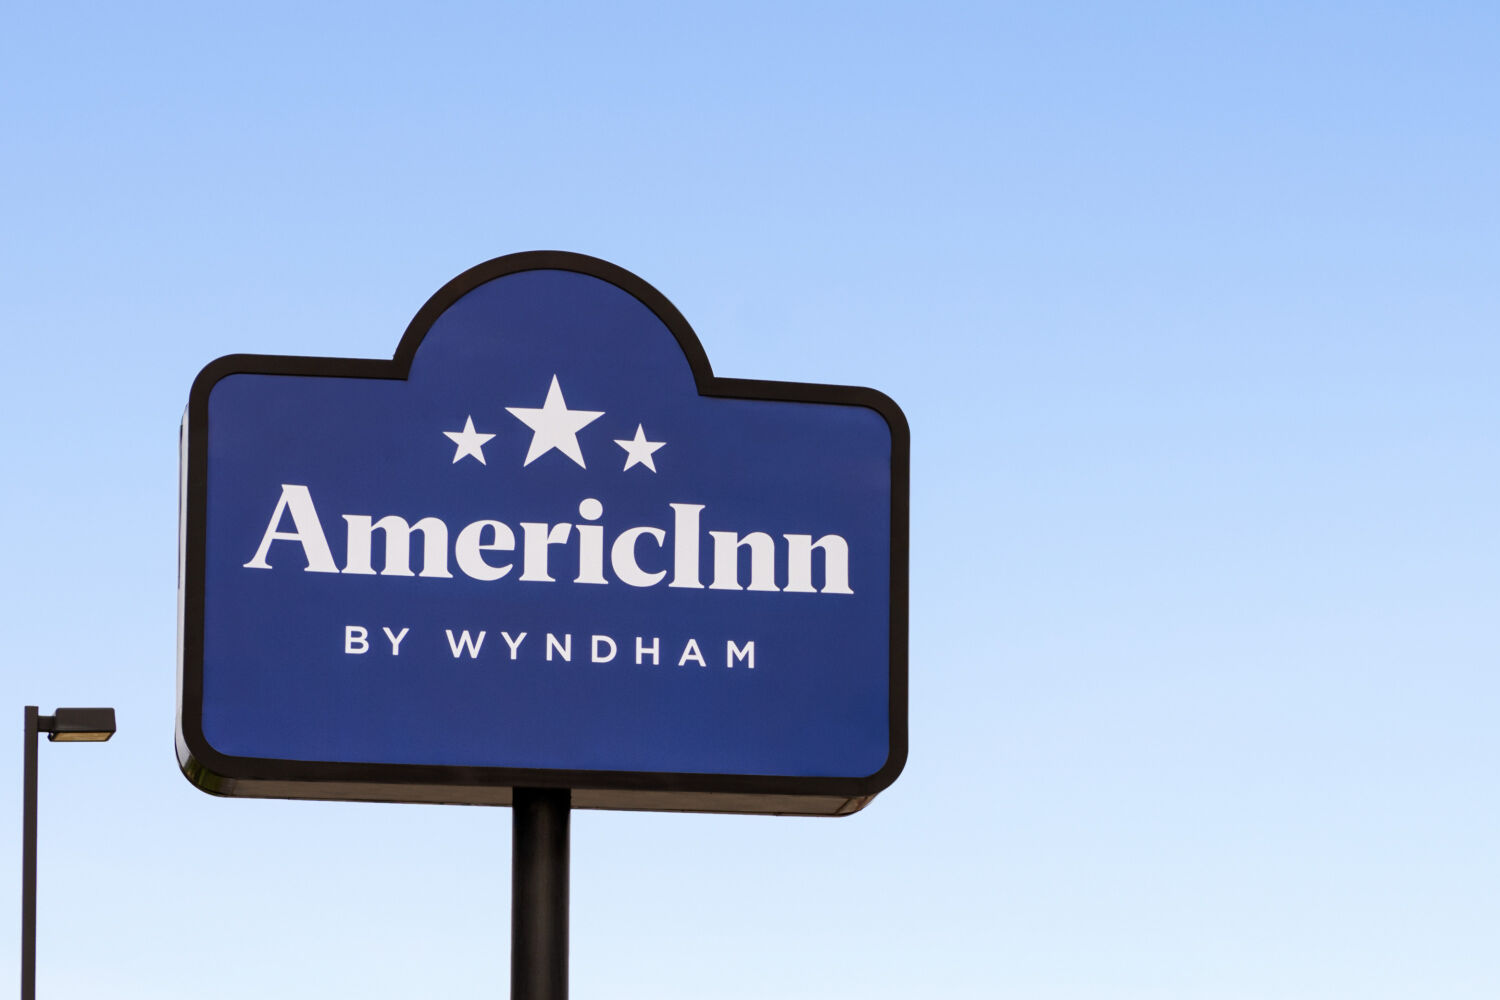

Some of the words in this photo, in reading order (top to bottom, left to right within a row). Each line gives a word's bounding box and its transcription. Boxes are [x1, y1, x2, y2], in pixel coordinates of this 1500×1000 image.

[242, 483, 855, 595] AmericInn
[344, 625, 410, 656] BY
[445, 629, 757, 669] WYNDHAM
